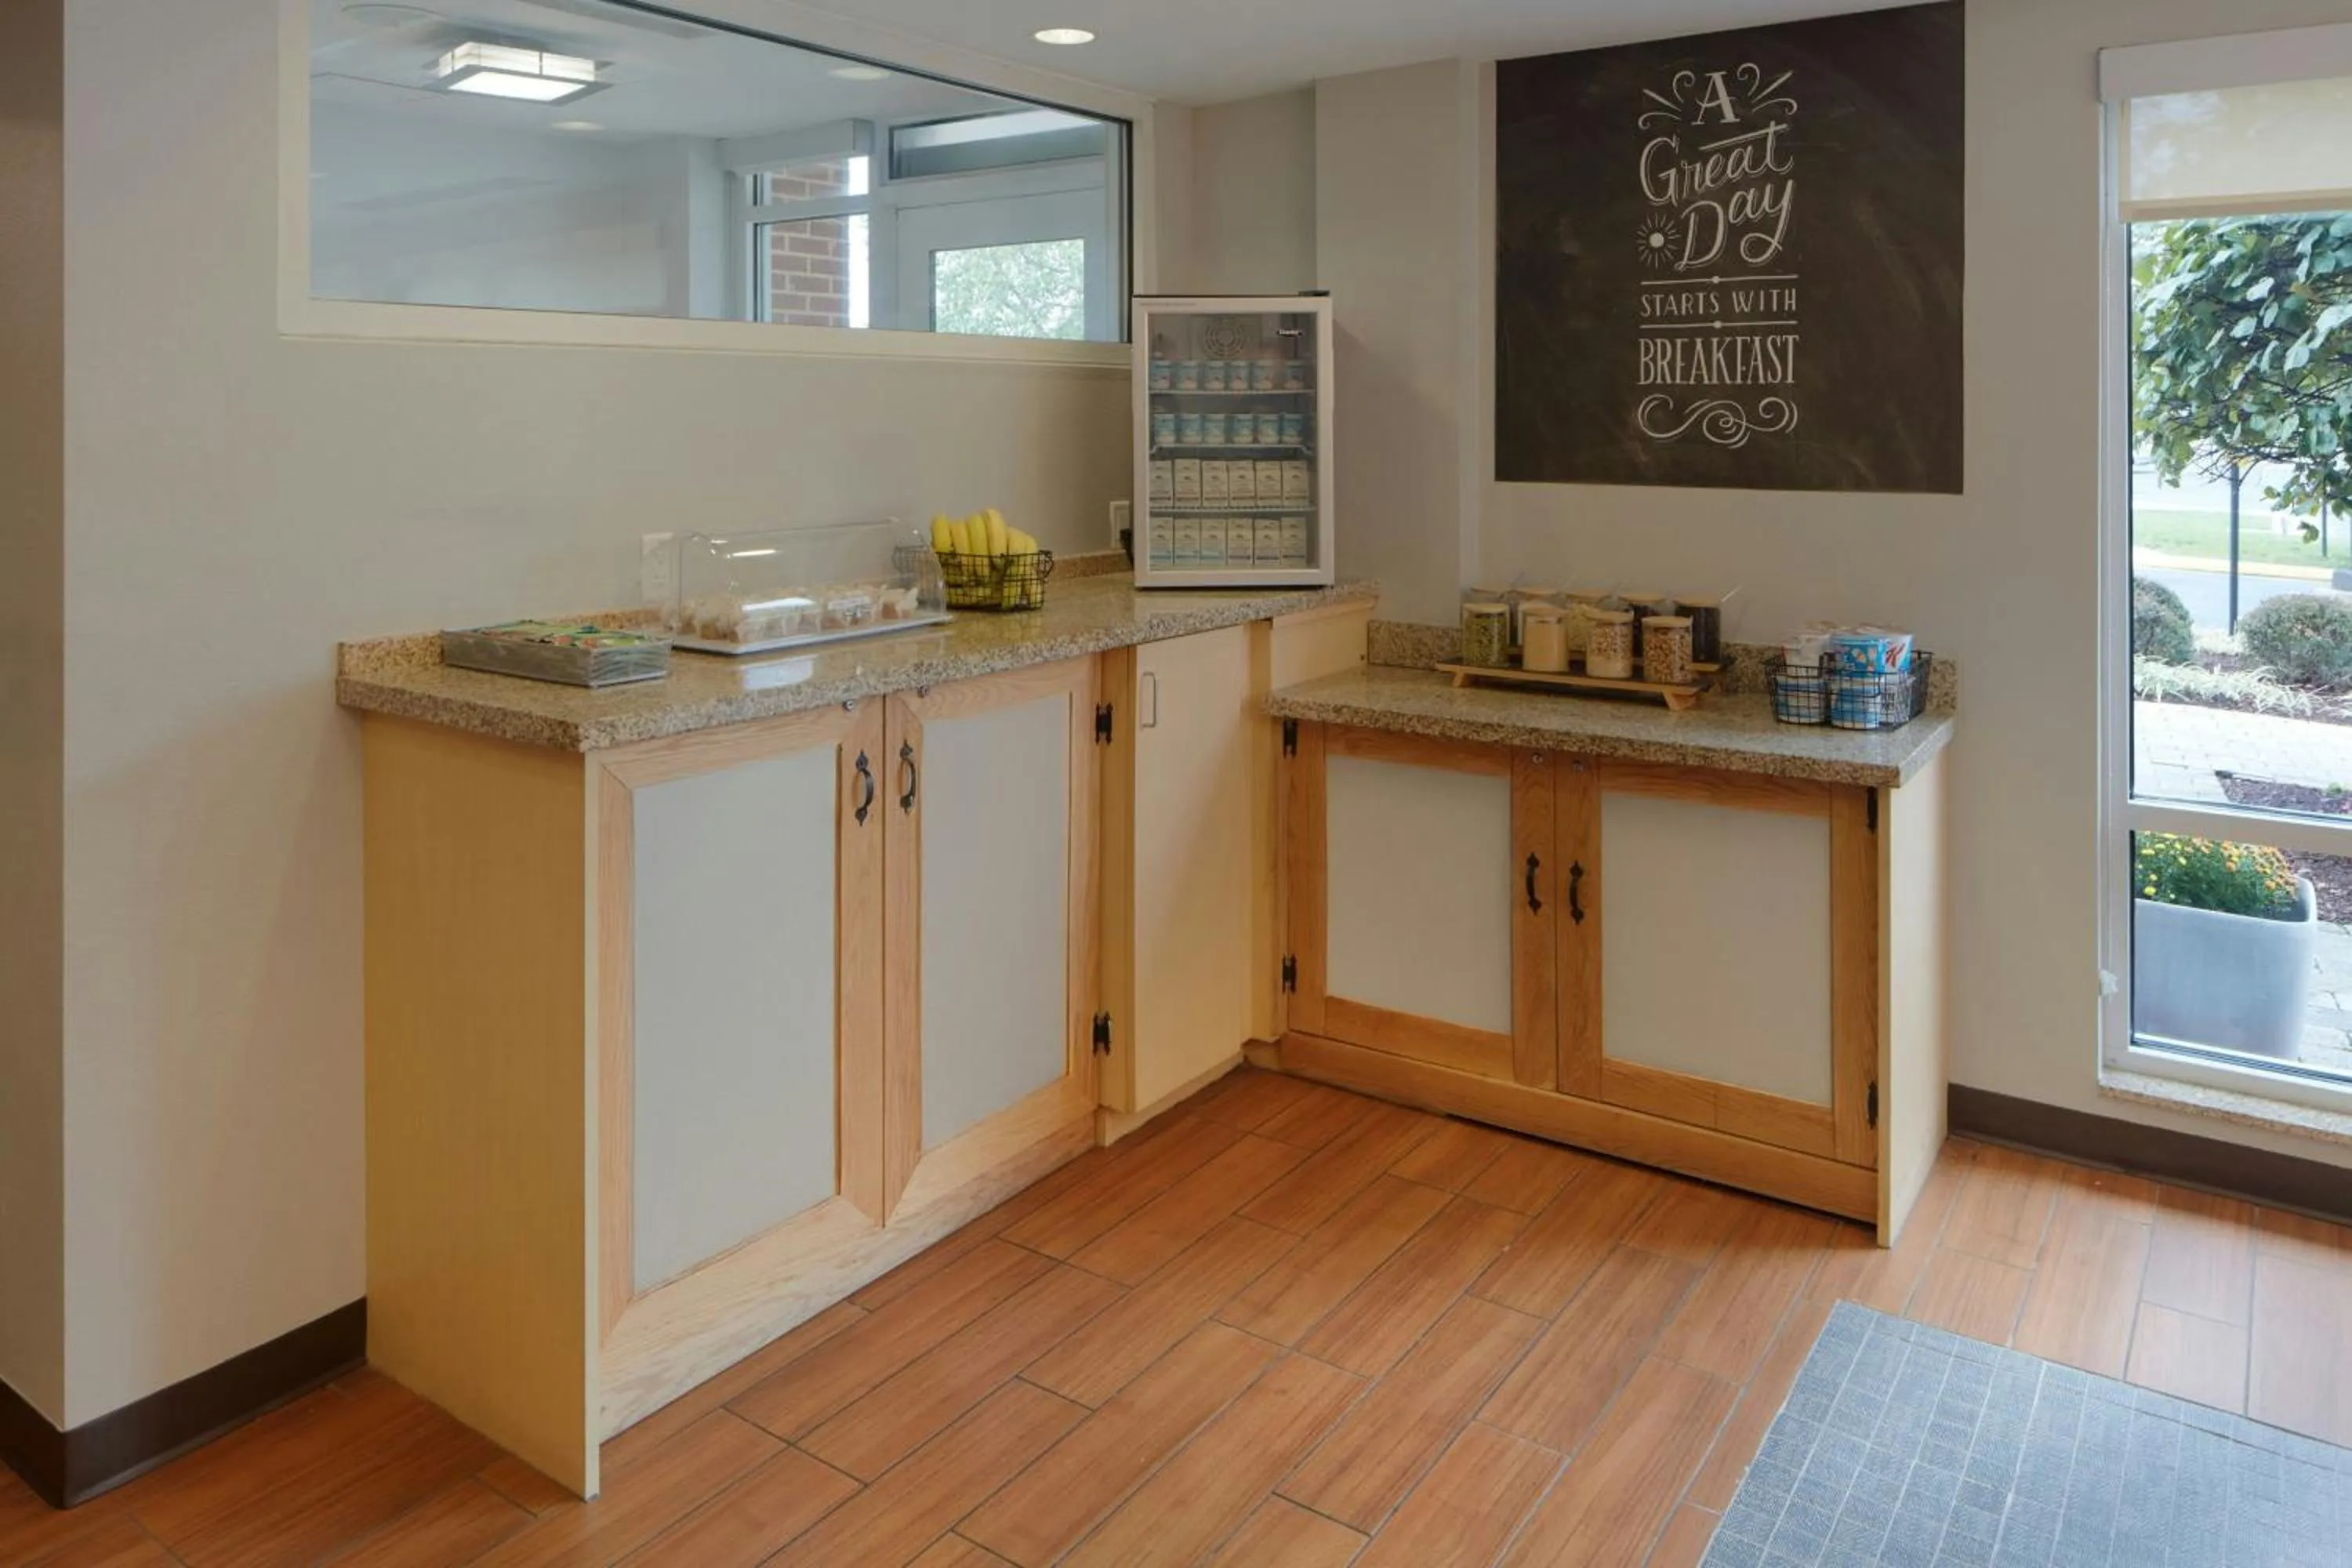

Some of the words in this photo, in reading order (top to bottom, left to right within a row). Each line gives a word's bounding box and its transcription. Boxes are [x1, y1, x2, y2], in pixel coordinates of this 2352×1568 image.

[1691, 71, 1740, 125] A
[1639, 121, 1794, 207] Great
[1675, 179, 1795, 270] Day
[1640, 291, 1721, 318] STARTS
[1732, 288, 1797, 314] WITH
[1637, 335, 1799, 385] BREAKFAST
